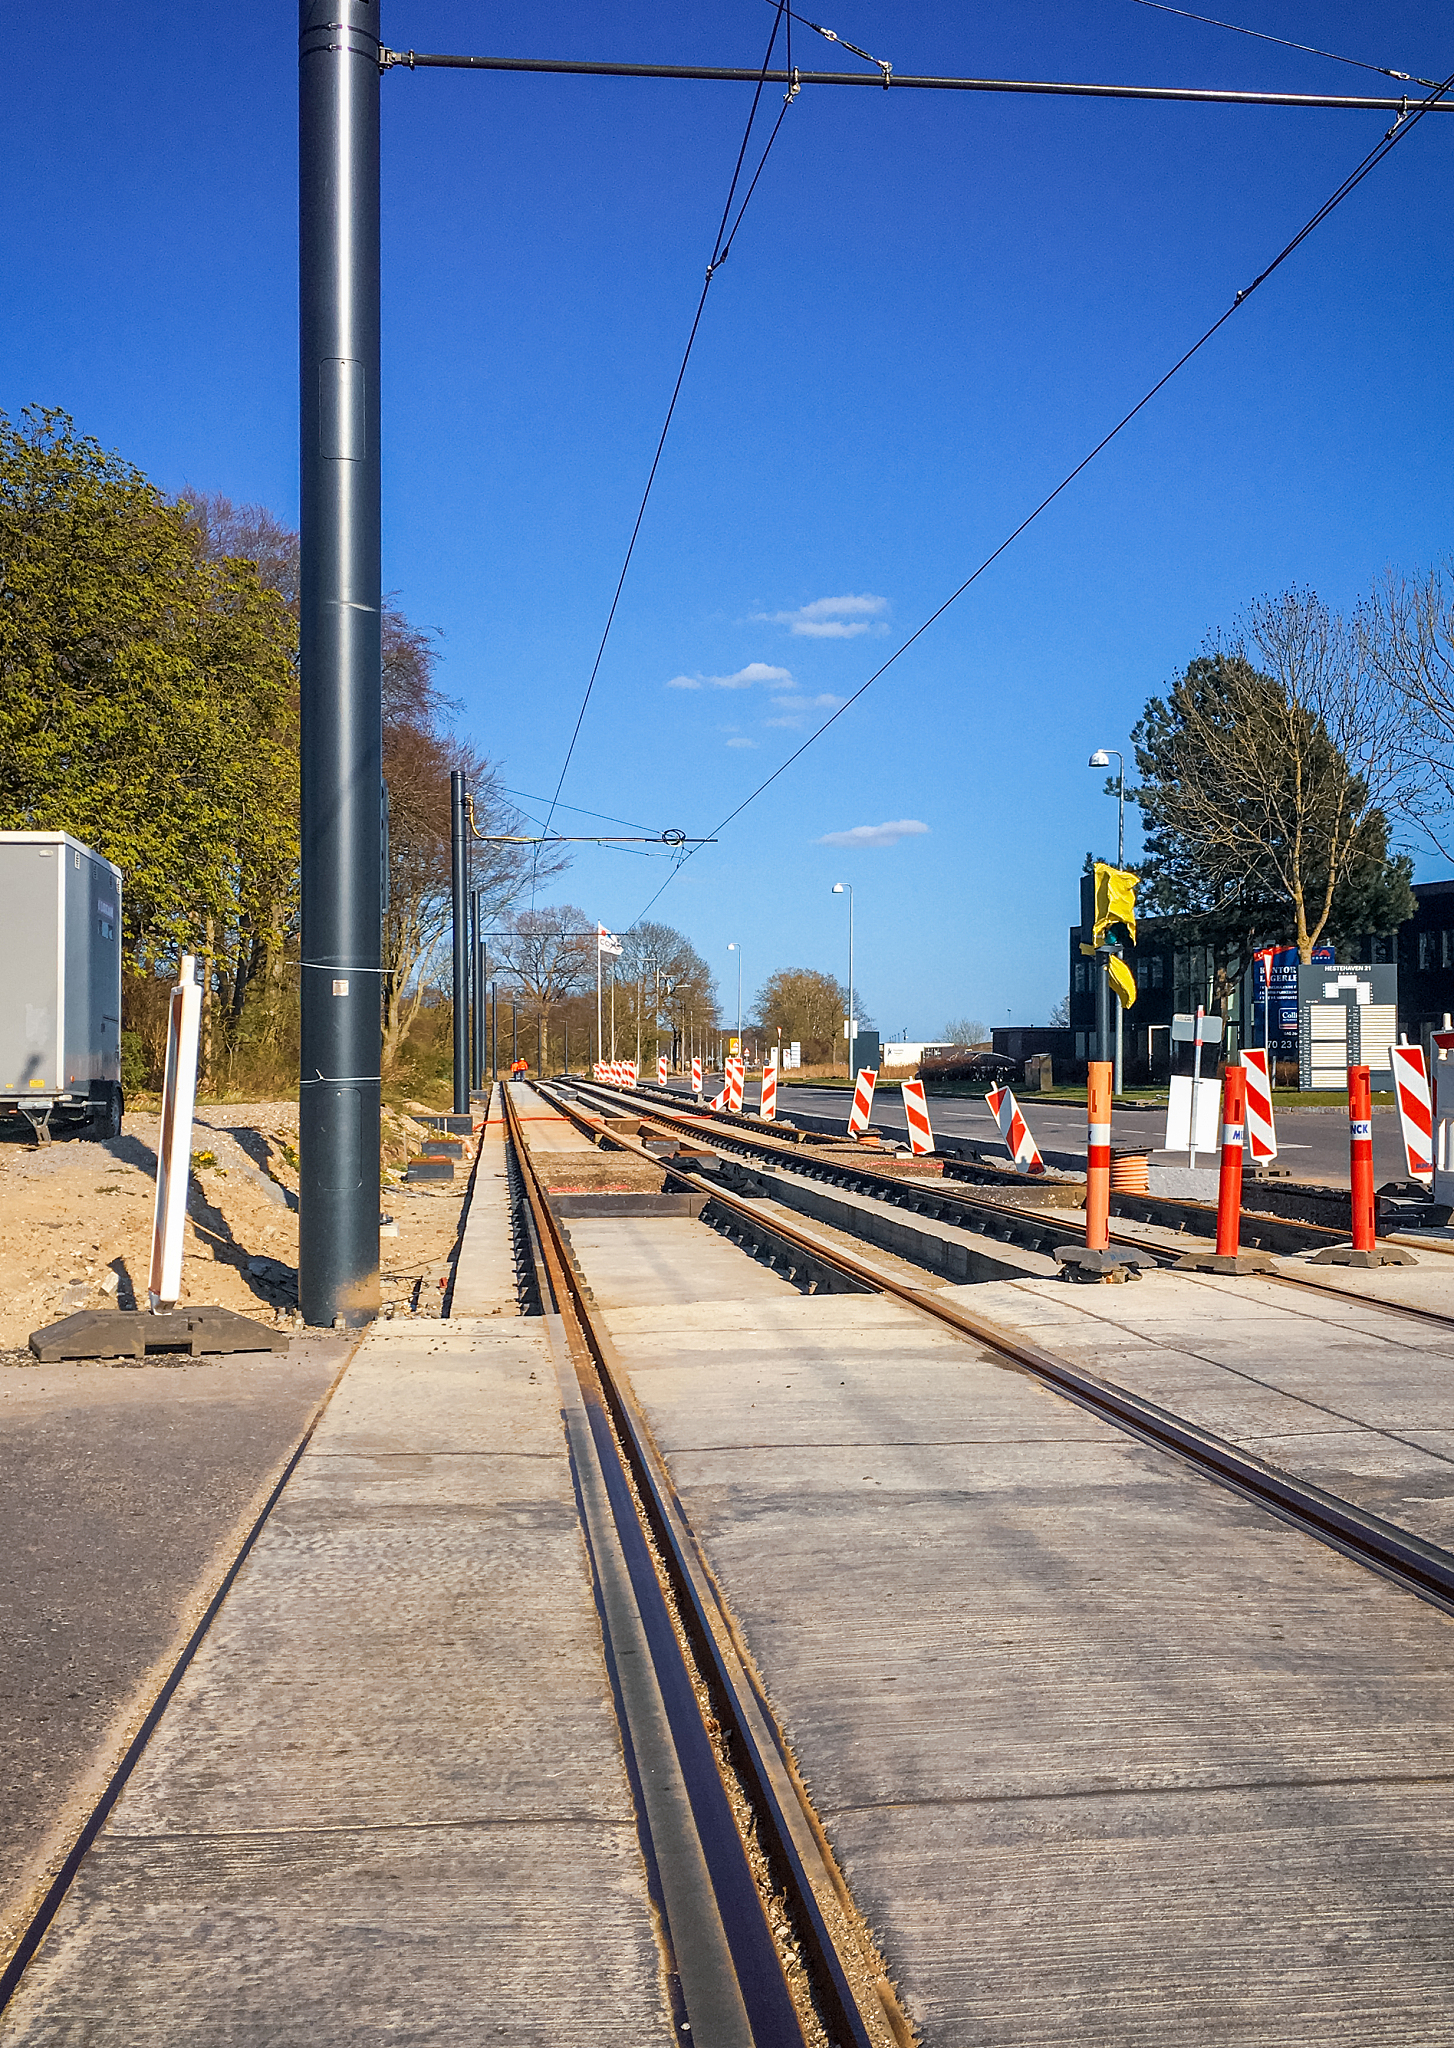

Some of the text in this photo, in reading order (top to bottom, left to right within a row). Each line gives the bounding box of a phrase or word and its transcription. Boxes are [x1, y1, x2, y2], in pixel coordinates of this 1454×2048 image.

[1259, 966, 1297, 974] KNTOR
[1259, 974, 1298, 982] LGERLE
[1280, 1040, 1292, 1049] 23
